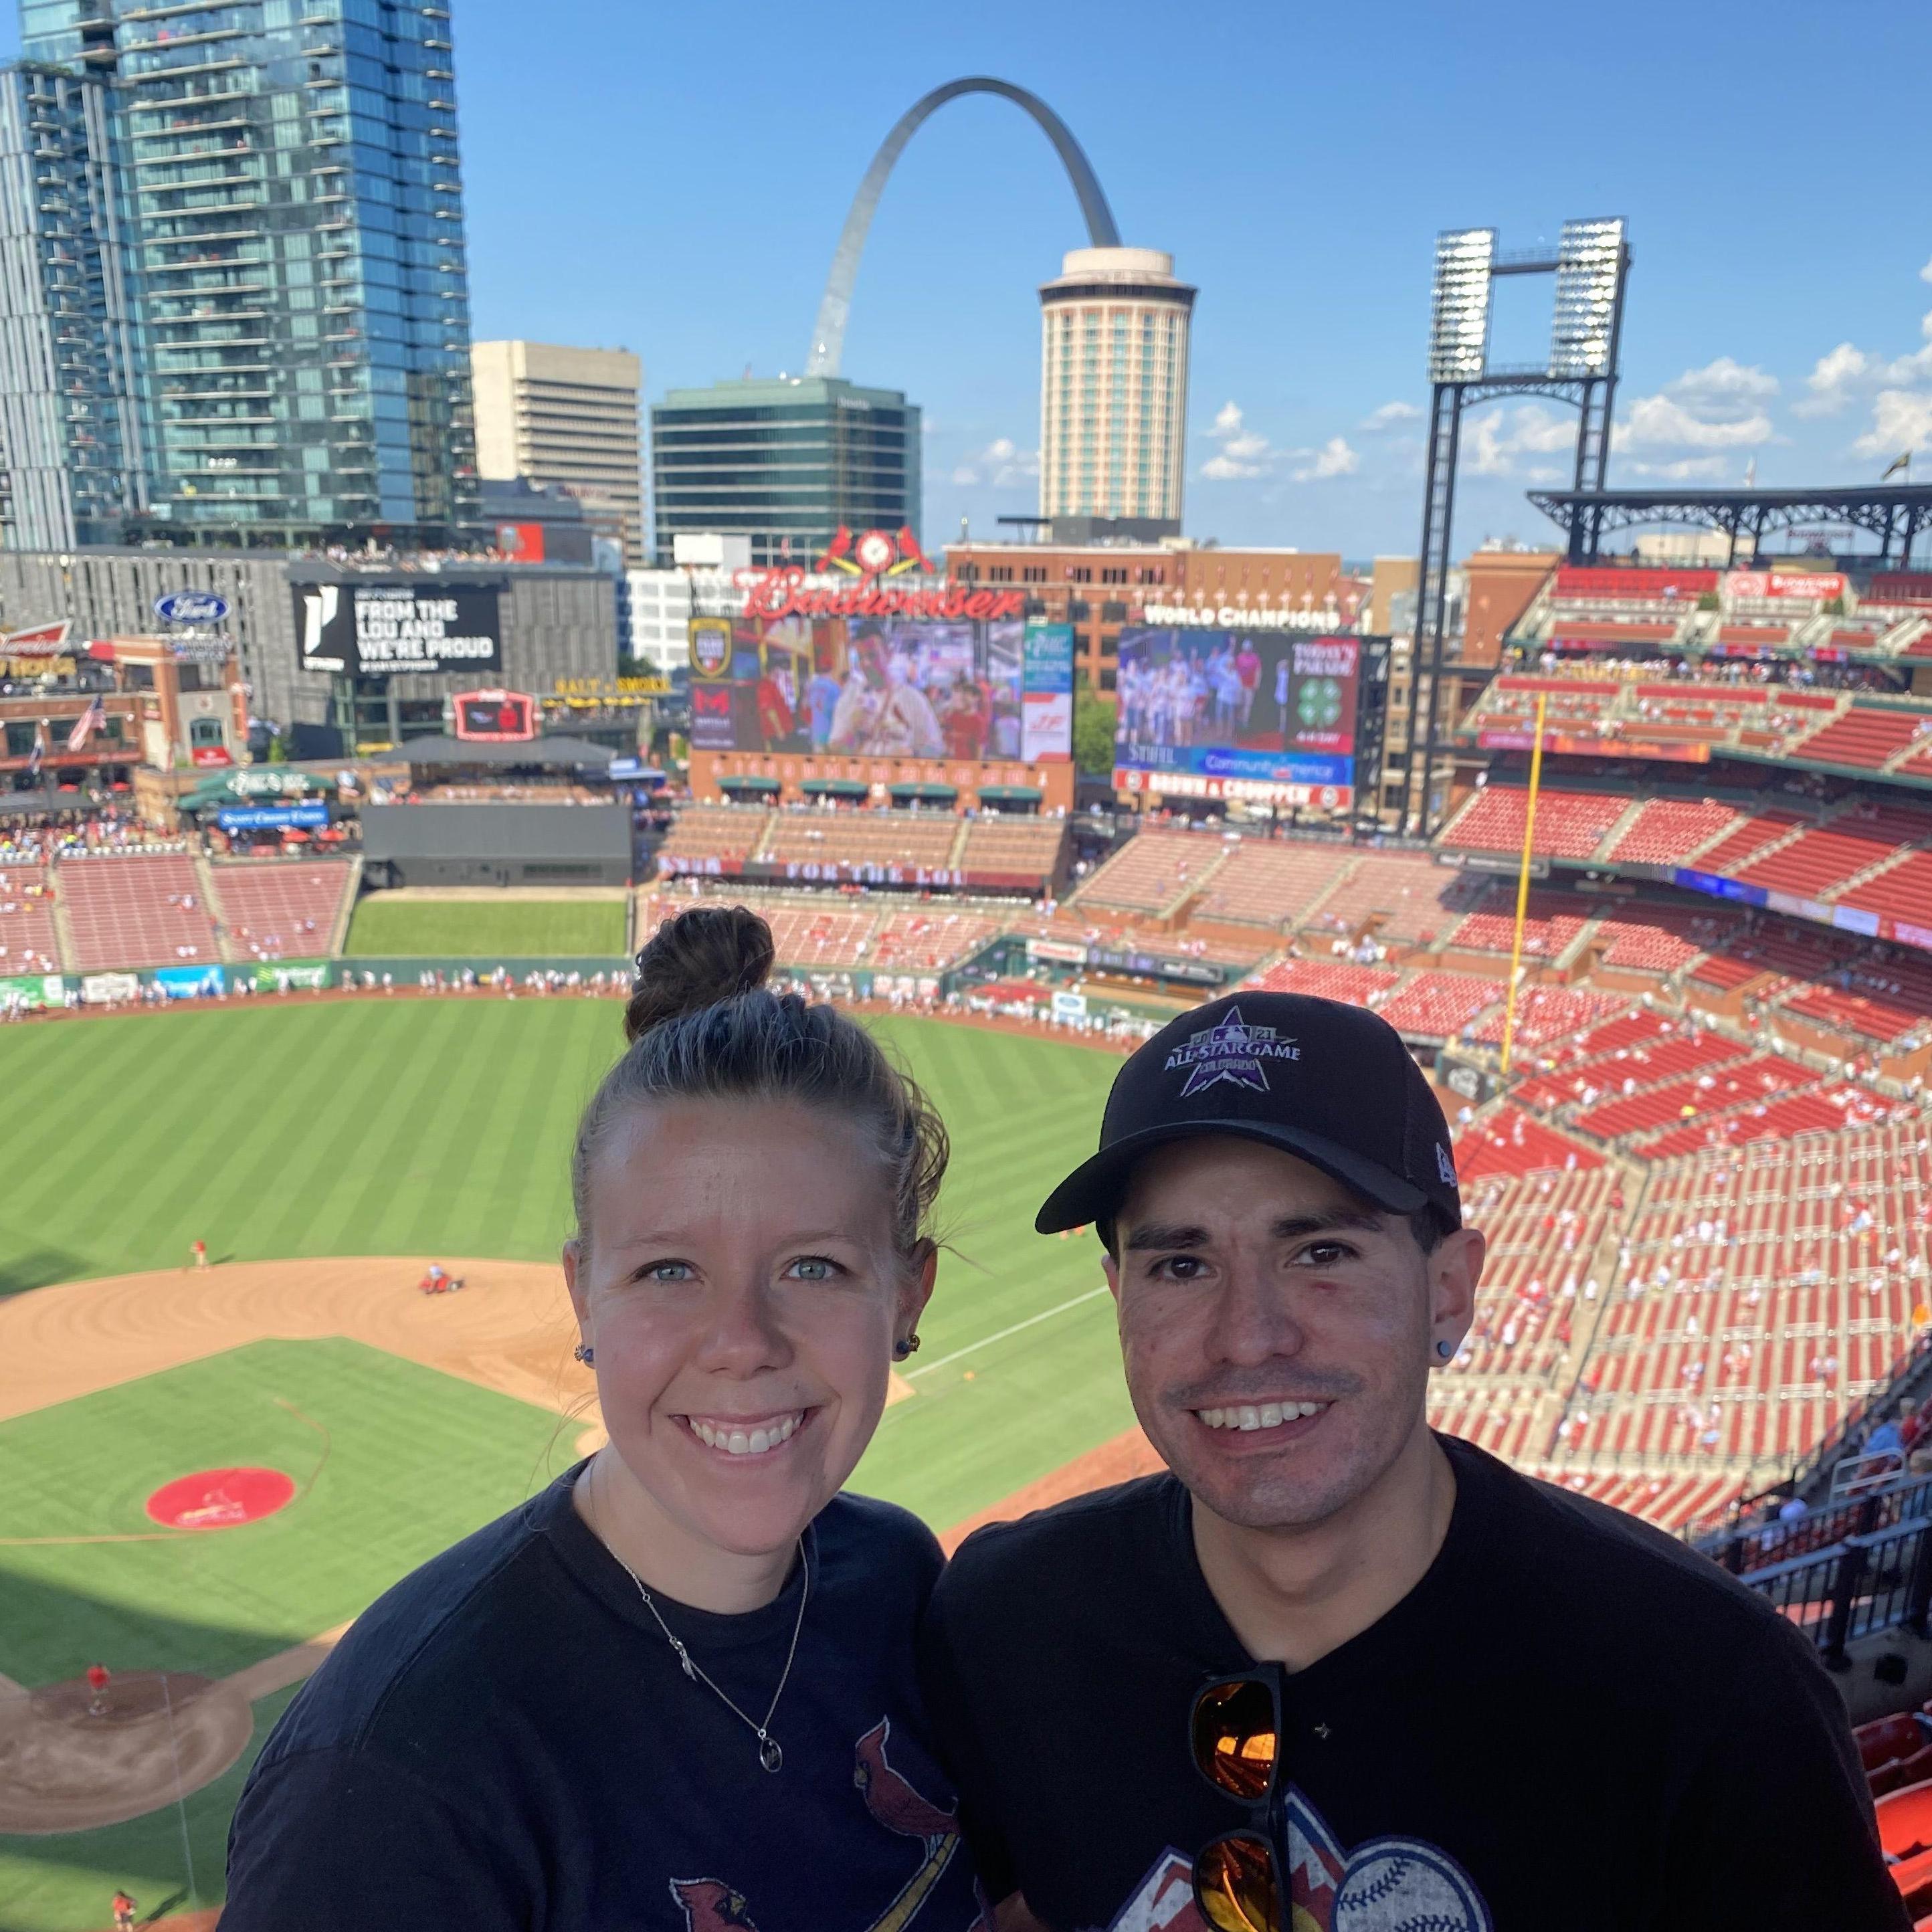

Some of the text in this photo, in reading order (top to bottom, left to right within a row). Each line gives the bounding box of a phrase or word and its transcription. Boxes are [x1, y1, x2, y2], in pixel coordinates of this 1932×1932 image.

[734, 565, 1025, 619] Budweiser
[170, 596, 218, 618] Ford
[355, 600, 458, 621] FROM THE
[1144, 605, 1341, 631] WORLD CHAMPIONS
[357, 620, 446, 639] LOU AND
[426, 637, 494, 659] PROUD
[787, 862, 837, 880] FOR
[852, 866, 902, 883] THE
[1246, 1042, 1301, 1062] GAME
